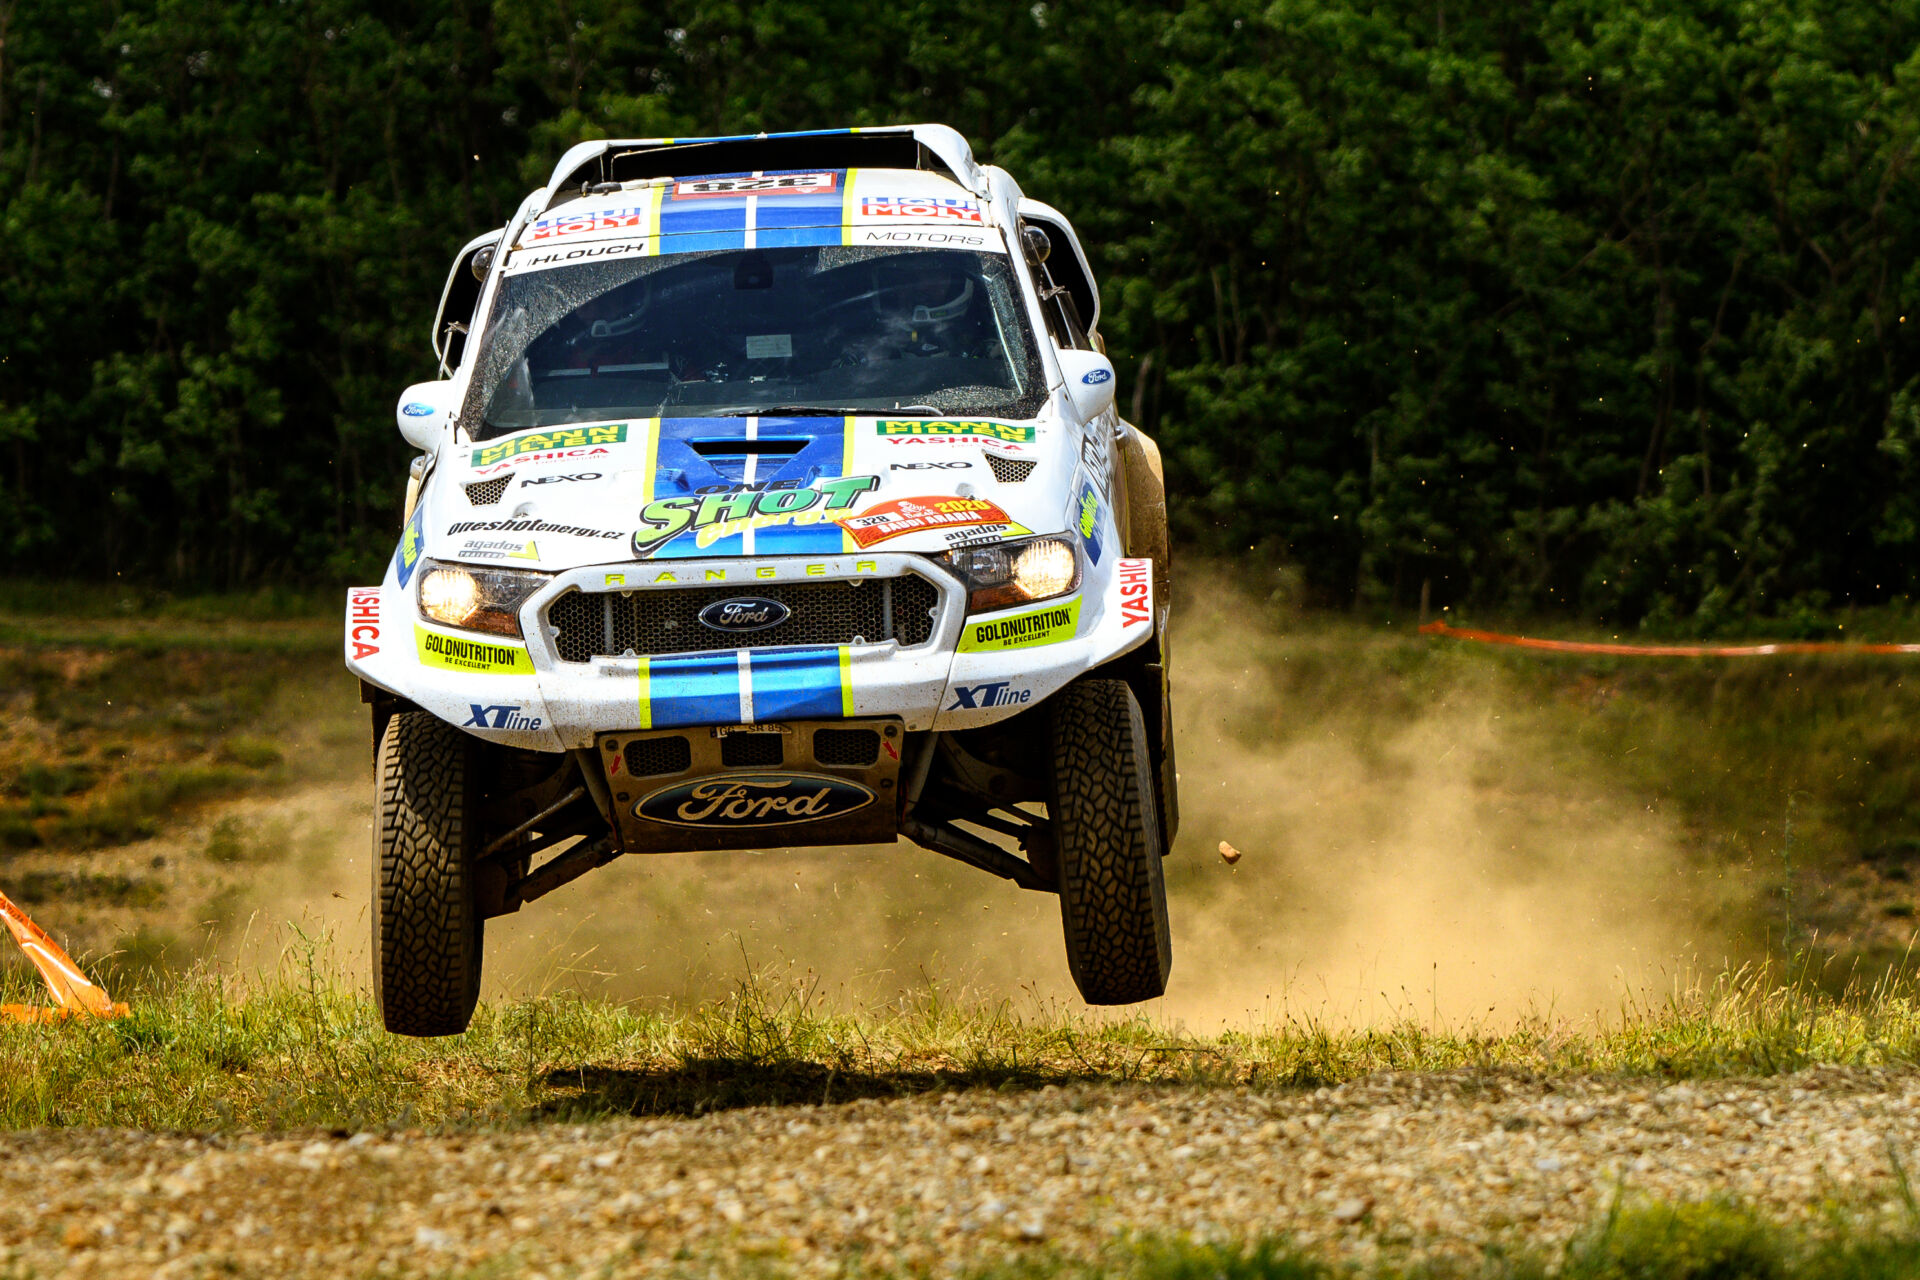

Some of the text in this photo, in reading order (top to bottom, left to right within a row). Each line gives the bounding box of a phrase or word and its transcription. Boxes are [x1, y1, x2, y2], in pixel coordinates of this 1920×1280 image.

[864, 197, 978, 209] LIQUI
[866, 204, 981, 221] MOLY
[527, 215, 640, 242] MOLY
[866, 231, 985, 245] MOTORS
[531, 243, 644, 266] HLOUCH
[1088, 370, 1108, 383] Ford
[885, 421, 1026, 434] MANN
[886, 427, 1026, 442] FILTER
[480, 434, 619, 466] FILTER
[482, 425, 619, 457] MANN
[886, 437, 1024, 451] YASHICA
[475, 447, 609, 475] YASHICA
[890, 461, 973, 471] NEXO
[520, 472, 603, 488] NEXO
[695, 477, 803, 495] ONE
[631, 475, 881, 558] SHOT
[934, 499, 992, 514] 2020
[447, 518, 625, 540] oneshotenergy.cz
[856, 515, 891, 527] 328
[877, 511, 983, 534] SAUDI ARABIA
[944, 524, 1008, 542] agados
[464, 540, 524, 551] agados
[605, 560, 877, 586] RANGER
[1119, 558, 1149, 628] YASHIC
[719, 602, 770, 625] Ford
[976, 608, 1071, 643] GOLDNUTRITION
[1003, 630, 1050, 646] BE EXCELLENT
[425, 634, 515, 666] GOLDNUTRITION
[445, 656, 491, 670] BE EXCELLENT
[945, 681, 1032, 711] XTline
[462, 703, 541, 731] XTline
[677, 779, 833, 821] Ford
